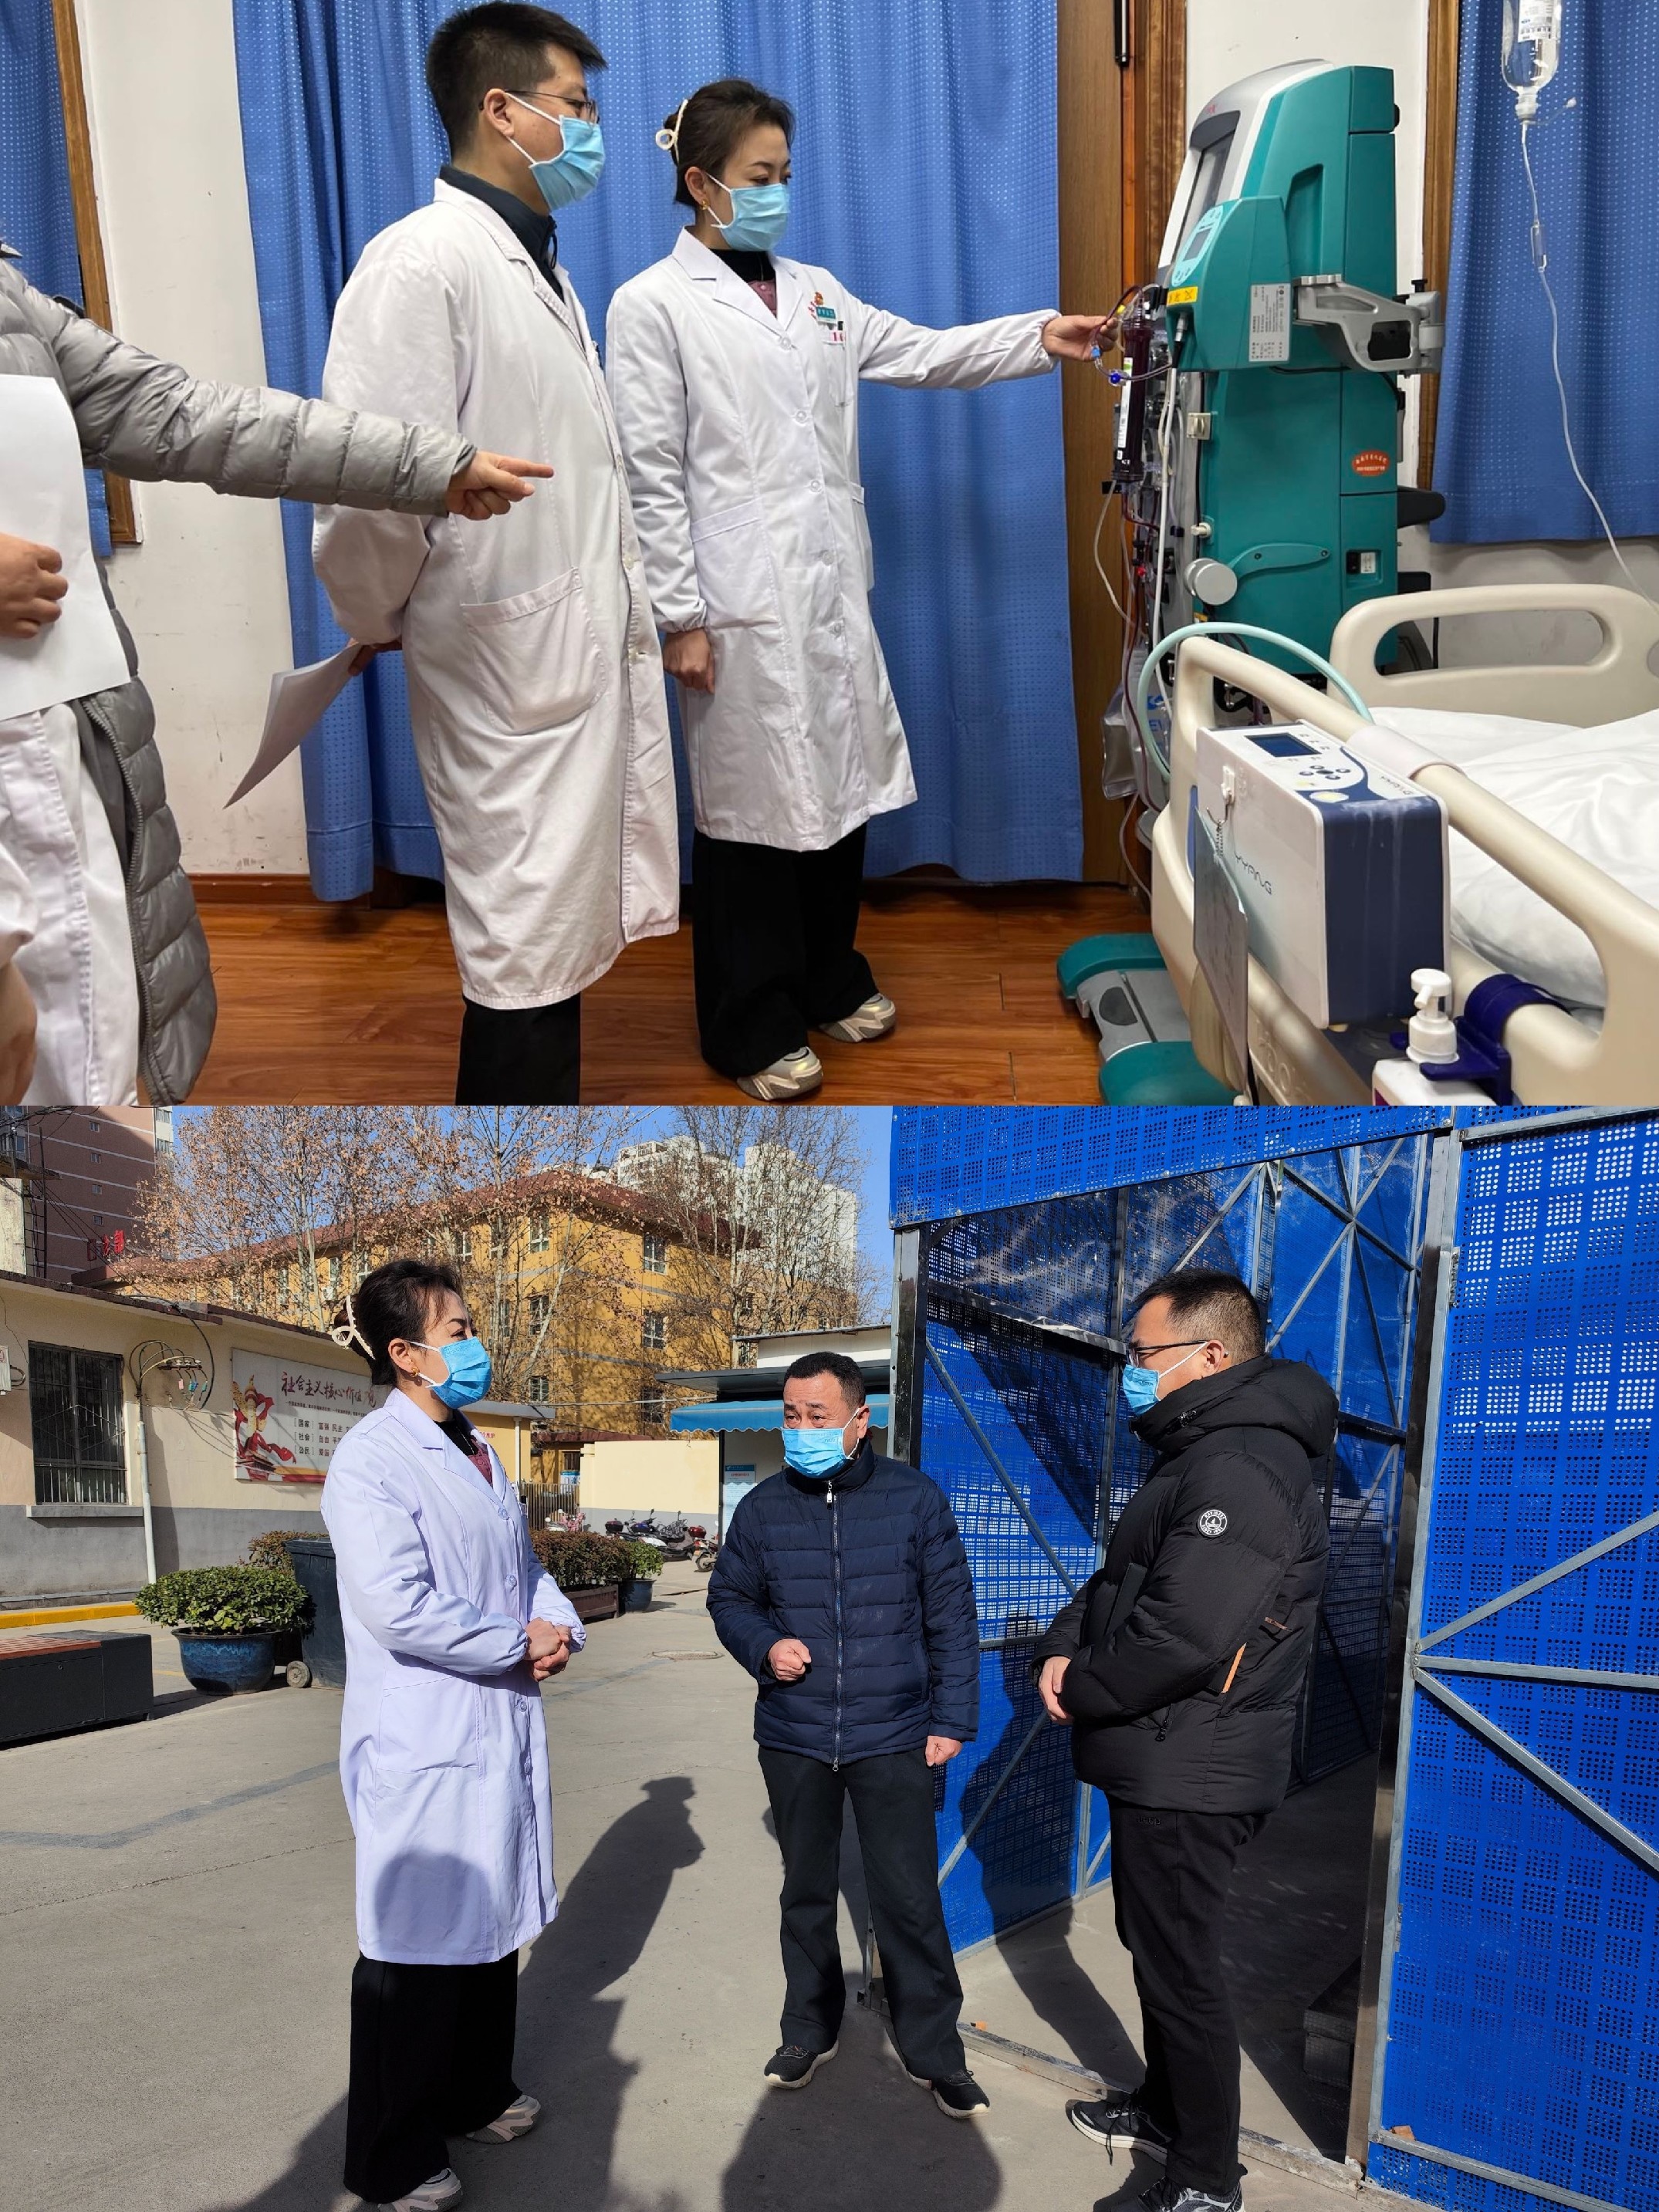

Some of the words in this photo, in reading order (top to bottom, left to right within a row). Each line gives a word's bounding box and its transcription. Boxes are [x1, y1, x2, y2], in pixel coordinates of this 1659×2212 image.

[281, 1370, 377, 1408] 社会主义核心价值观
